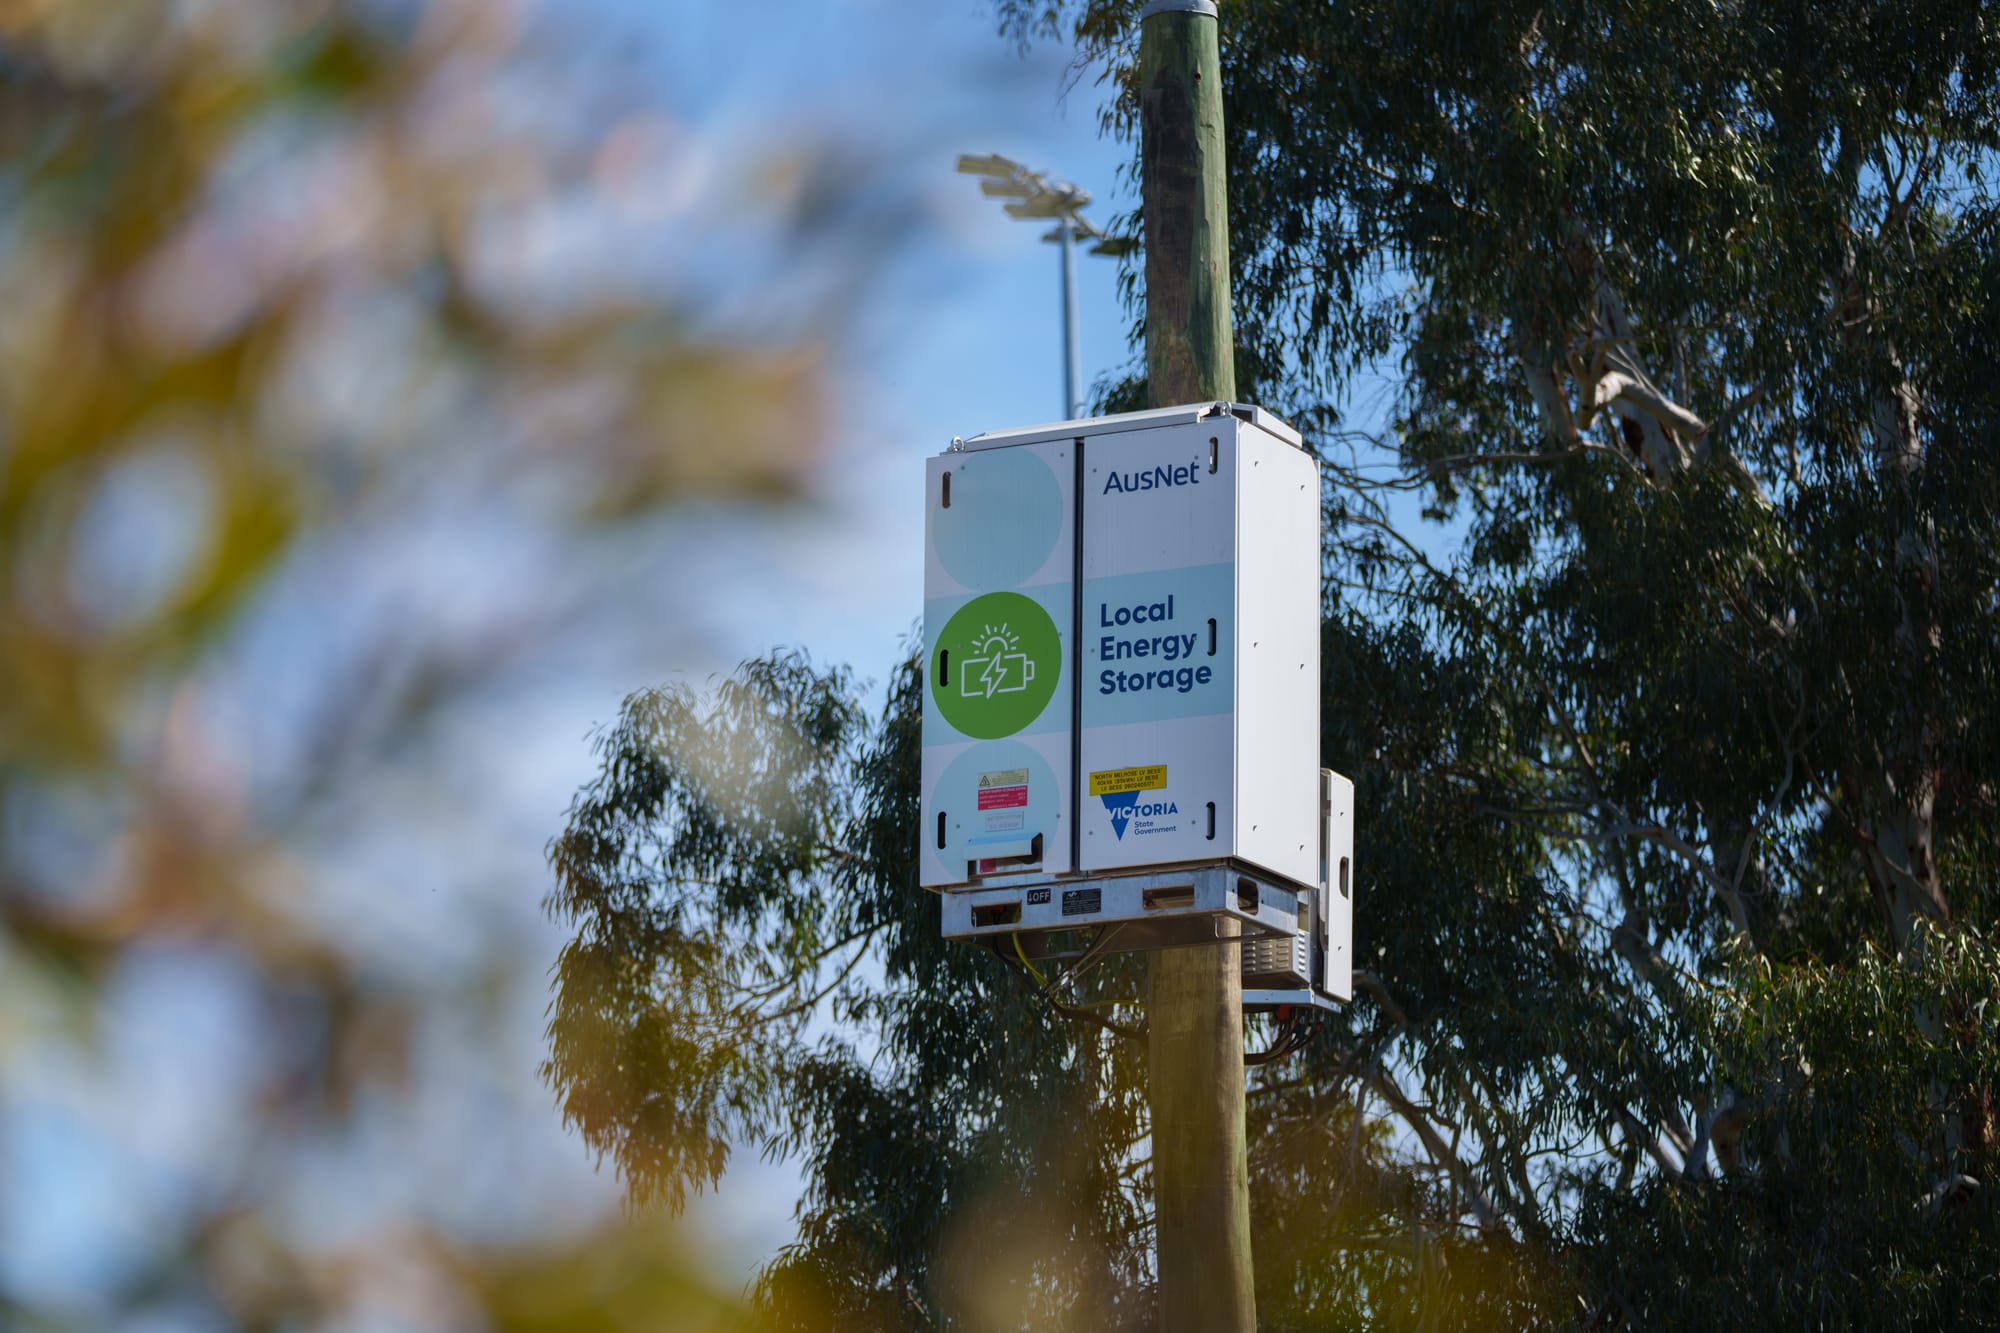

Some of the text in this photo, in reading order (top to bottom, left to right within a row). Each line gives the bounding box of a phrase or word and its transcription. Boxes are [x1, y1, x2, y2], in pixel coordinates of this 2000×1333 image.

[1103, 461, 1200, 495] AusNet
[1100, 594, 1173, 628] Local
[1100, 633, 1197, 661] Energy
[1099, 665, 1212, 695] Storage
[1108, 801, 1178, 819] VICTORIA
[1134, 820, 1154, 829] State
[1134, 825, 1177, 836] Government
